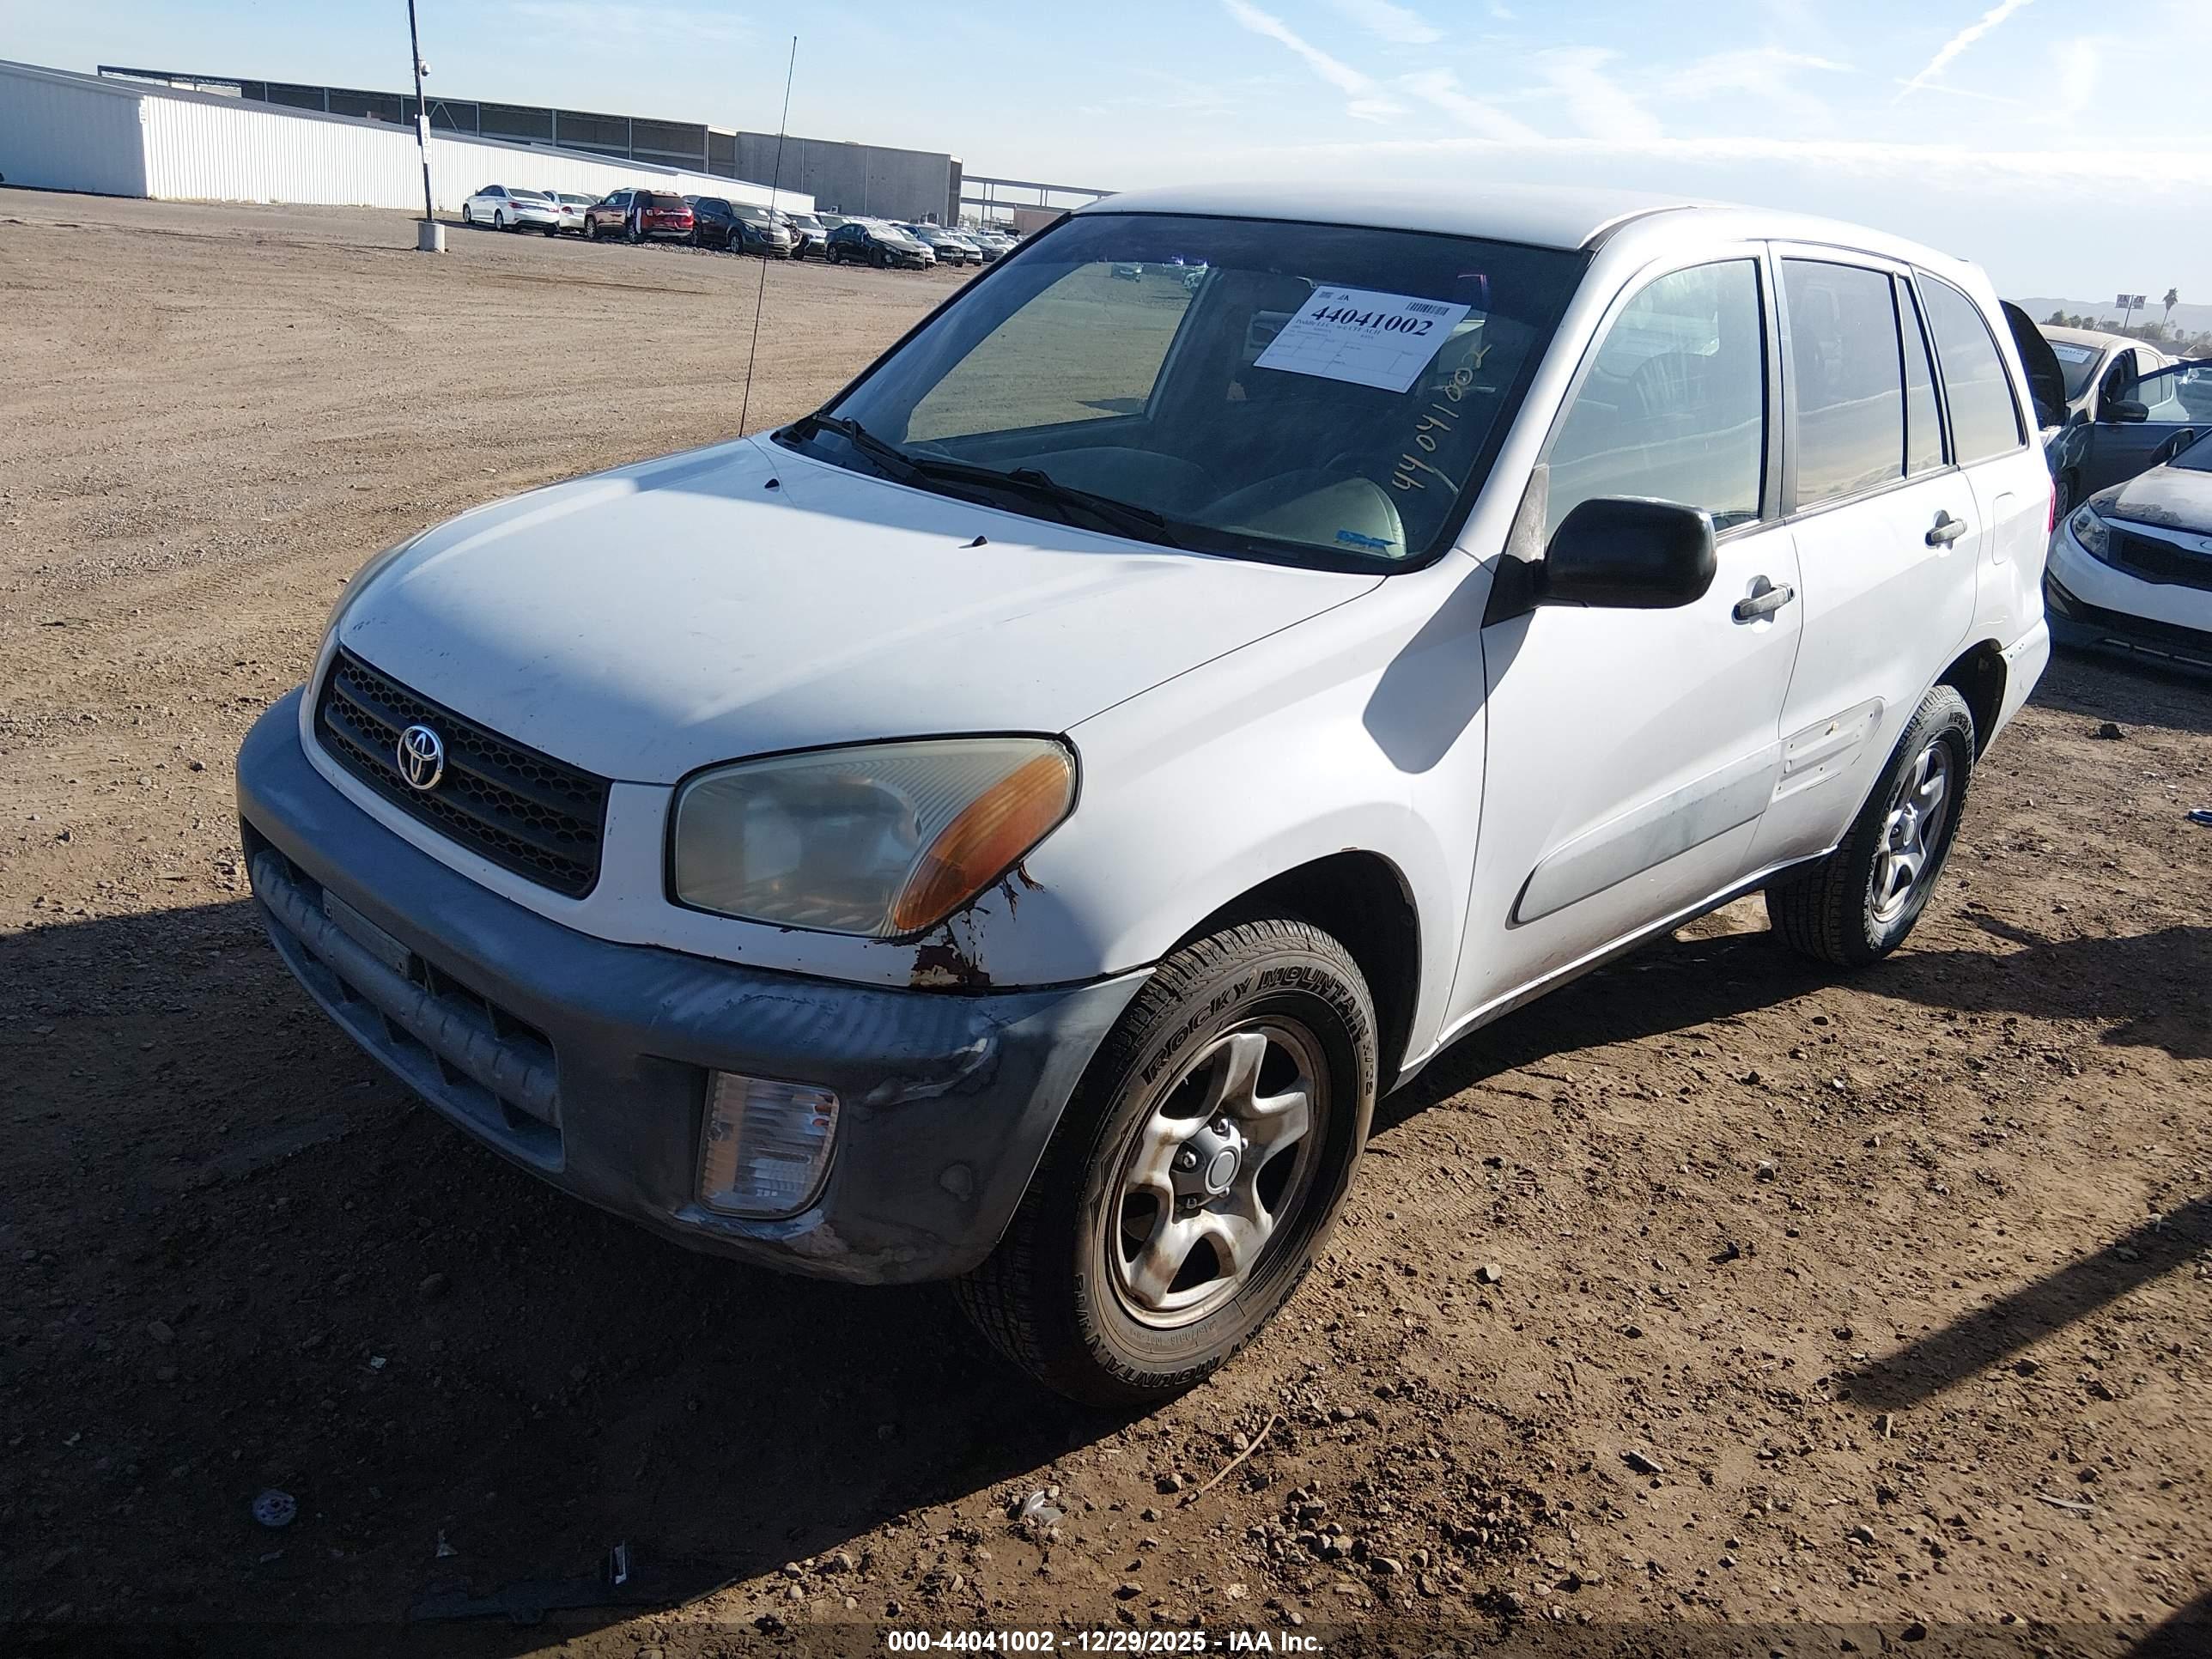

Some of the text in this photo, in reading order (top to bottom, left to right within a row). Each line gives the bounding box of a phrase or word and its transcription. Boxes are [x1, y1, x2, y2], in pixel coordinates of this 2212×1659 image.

[1311, 305, 1434, 337] 44041002
[1140, 975, 1255, 1086] ROCKY
[1255, 964, 1370, 1044] MOUNTAIN
